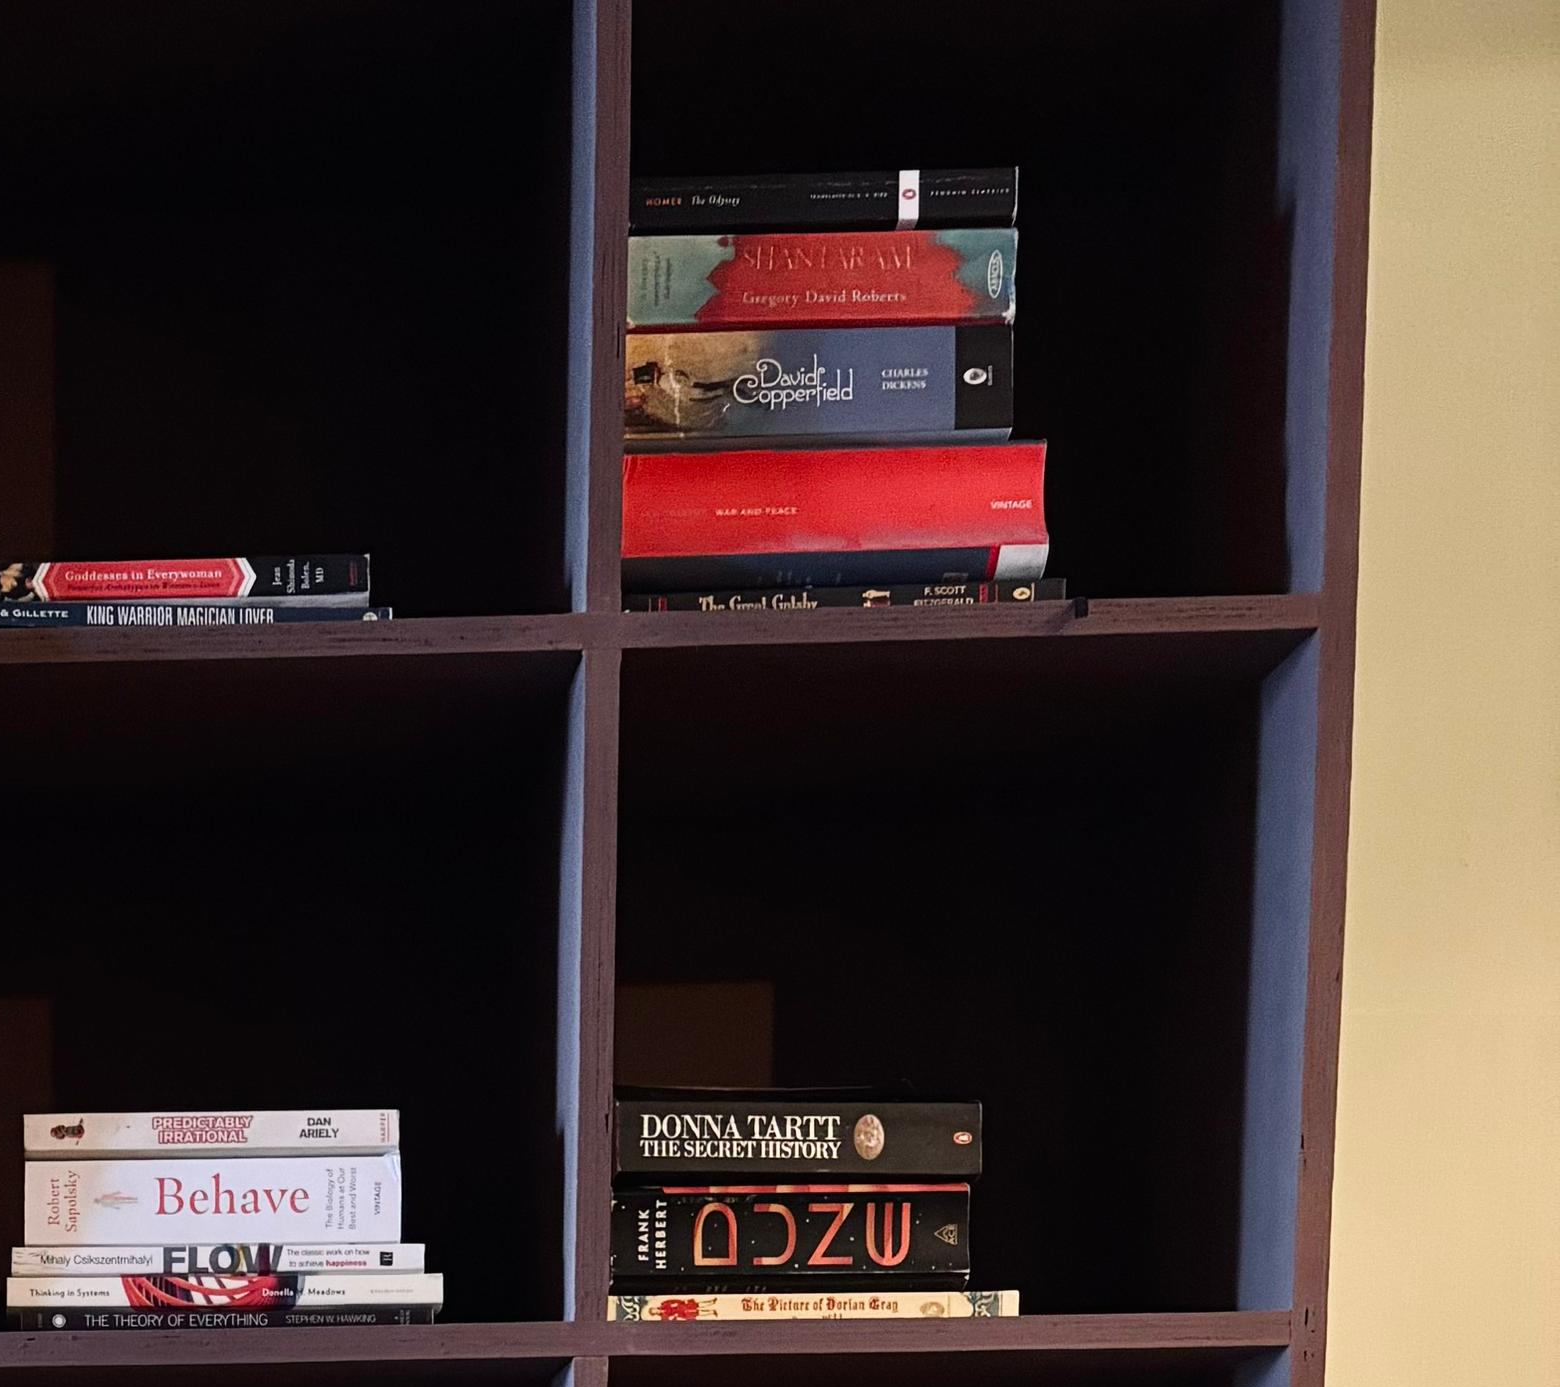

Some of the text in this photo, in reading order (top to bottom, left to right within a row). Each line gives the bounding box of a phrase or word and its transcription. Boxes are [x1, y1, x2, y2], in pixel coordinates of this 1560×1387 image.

[741, 244, 916, 271] SHANTARAM
[742, 289, 907, 308] Gregory David Roberts
[756, 353, 817, 387] David
[882, 368, 929, 378] CHARLES
[733, 366, 854, 410] Copperfield
[882, 380, 926, 390] DICKENS
[65, 568, 222, 582] Goddesses in Everywoman
[87, 606, 113, 625] KING
[117, 606, 172, 625] WARRIOR
[176, 606, 234, 625] MAGICIAN
[152, 1115, 252, 1130] PREDICTABLY
[307, 1117, 331, 1127] DAN
[641, 1114, 840, 1140] DONNA TARTT
[157, 1129, 248, 1144] IRRATIONAL
[299, 1127, 339, 1139] ARIELY
[640, 1140, 841, 1159] THE SECRET HISTORY
[49, 1178, 60, 1226] Robert
[66, 1170, 80, 1232] Sapolsky
[154, 1173, 309, 1215] Behave
[639, 1209, 649, 1260] FRANK
[656, 1200, 667, 1269] HERBERT
[40, 1254, 71, 1266] Mihaly
[163, 1244, 283, 1274] FLOW
[85, 1313, 267, 1327] THE THEORY OF EVERYTHING
